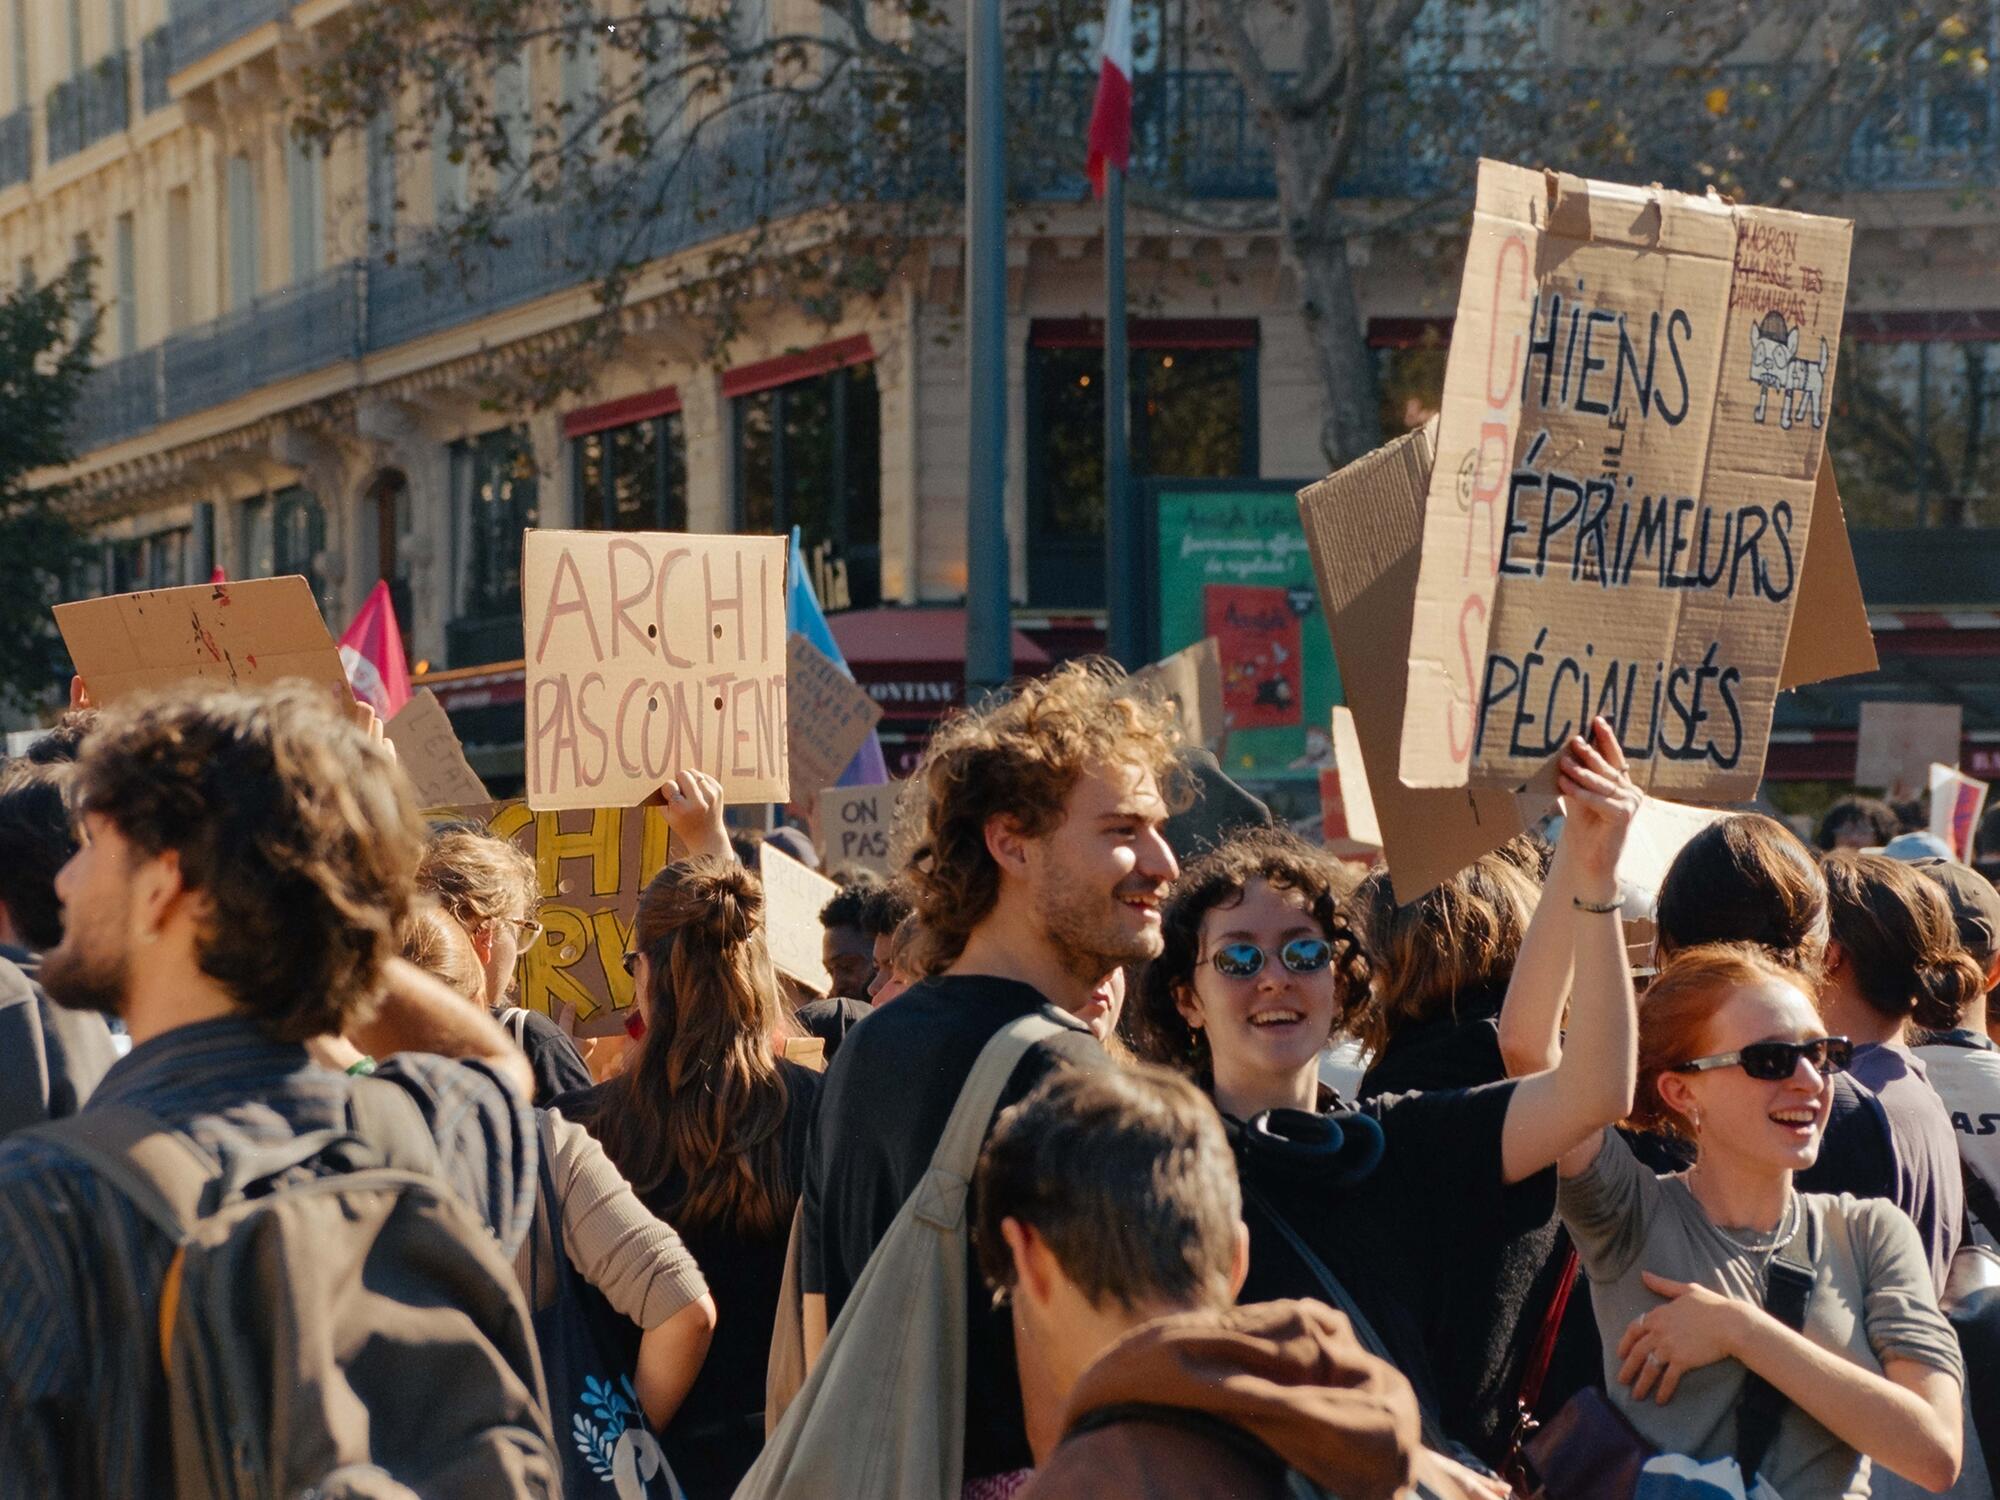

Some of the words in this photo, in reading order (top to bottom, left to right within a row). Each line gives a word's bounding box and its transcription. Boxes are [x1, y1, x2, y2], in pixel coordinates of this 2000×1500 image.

[535, 537, 771, 669] ARCHI
[532, 671, 609, 795] PAS
[842, 797, 878, 823] ON
[842, 830, 889, 858] PAS
